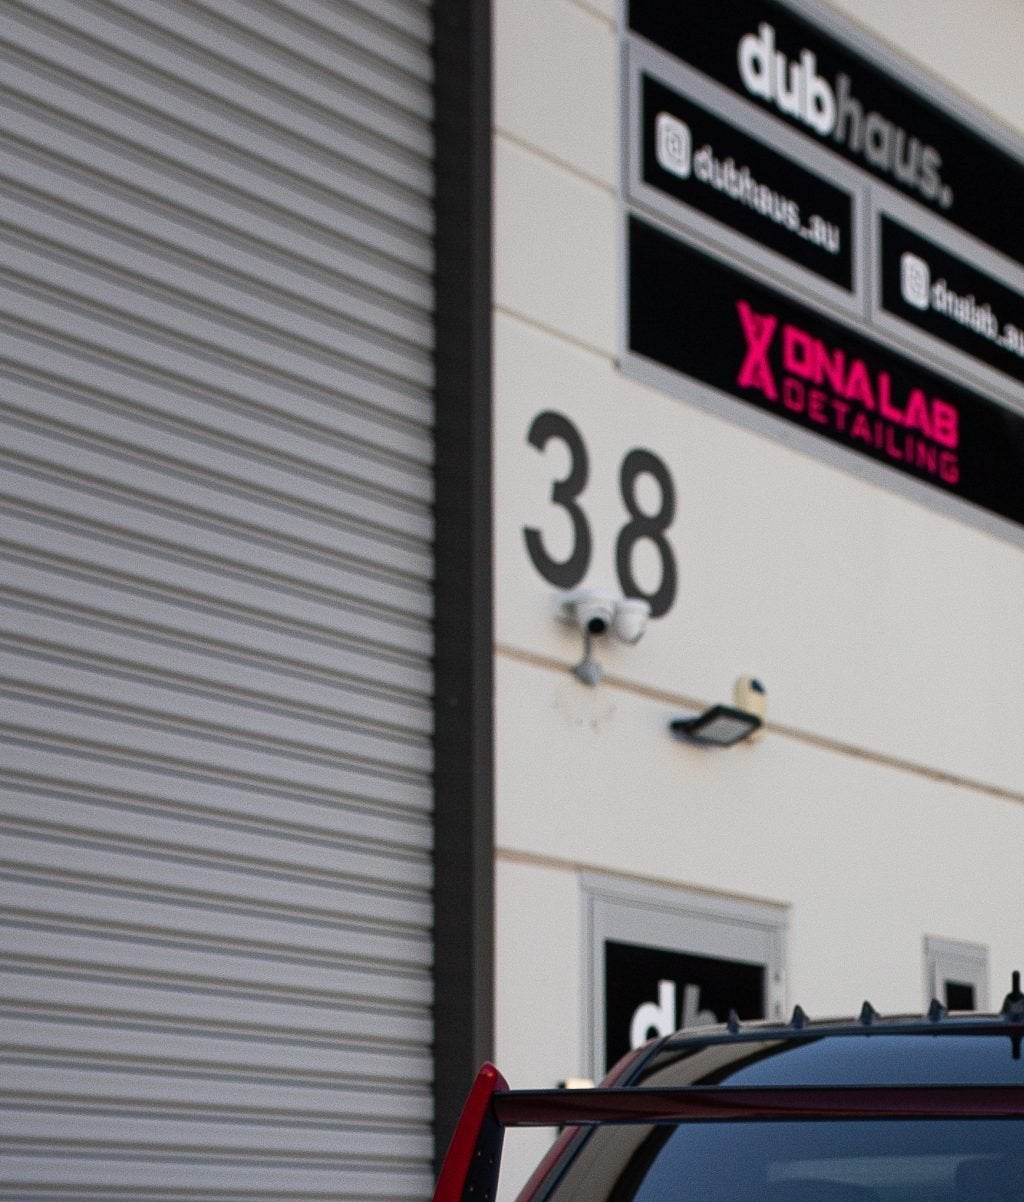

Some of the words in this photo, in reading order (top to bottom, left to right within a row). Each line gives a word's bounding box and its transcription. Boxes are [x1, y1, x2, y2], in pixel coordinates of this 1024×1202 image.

[694, 144, 841, 255] dubhaus_au
[782, 376, 961, 485] DETAILING
[521, 408, 678, 619] 38
